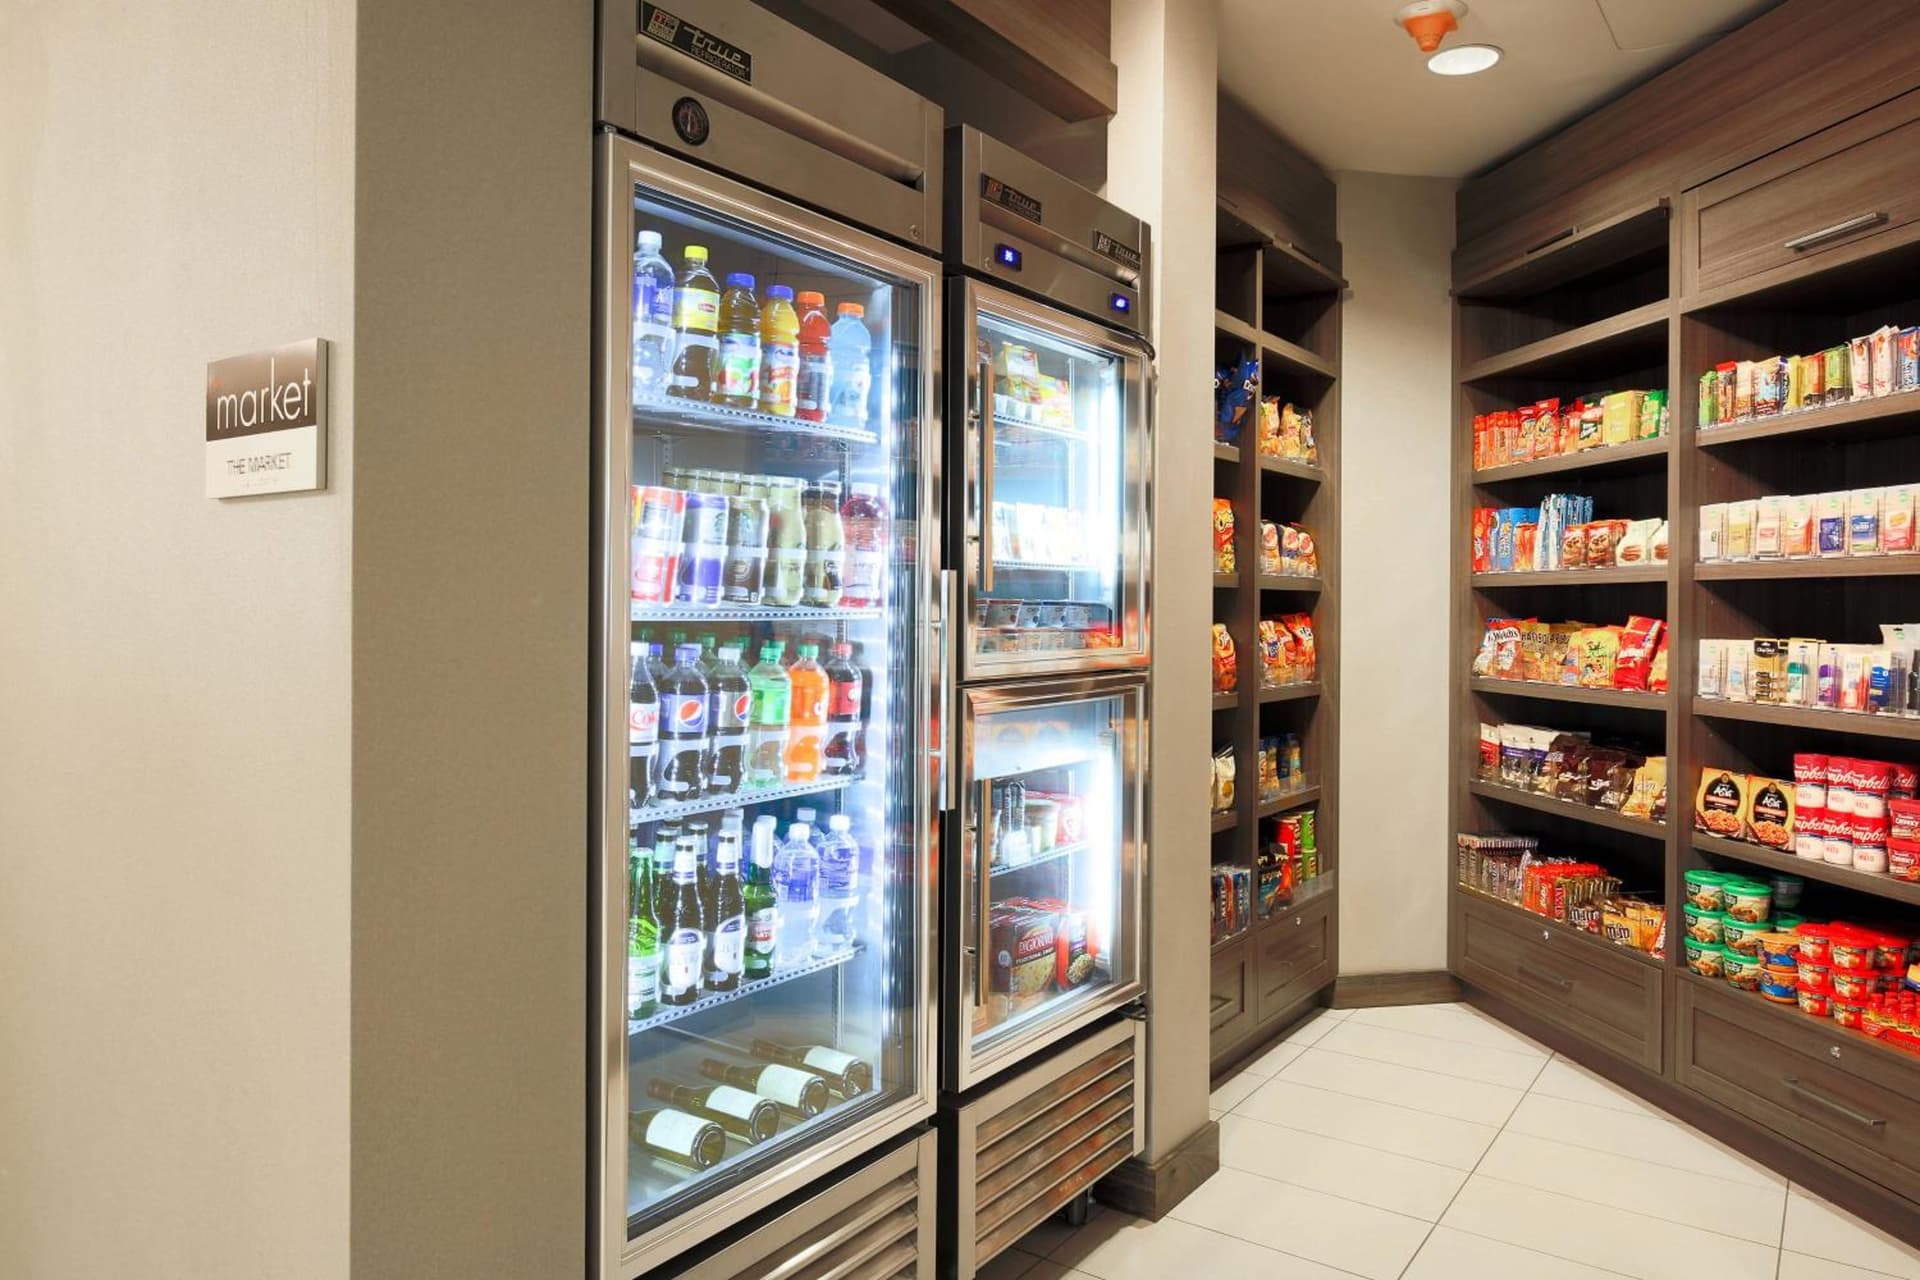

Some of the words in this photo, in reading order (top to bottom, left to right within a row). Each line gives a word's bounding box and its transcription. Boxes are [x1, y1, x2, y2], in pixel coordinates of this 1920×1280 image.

[217, 356, 311, 431] market
[226, 458, 247, 476] THE
[248, 451, 293, 474] MARKET
